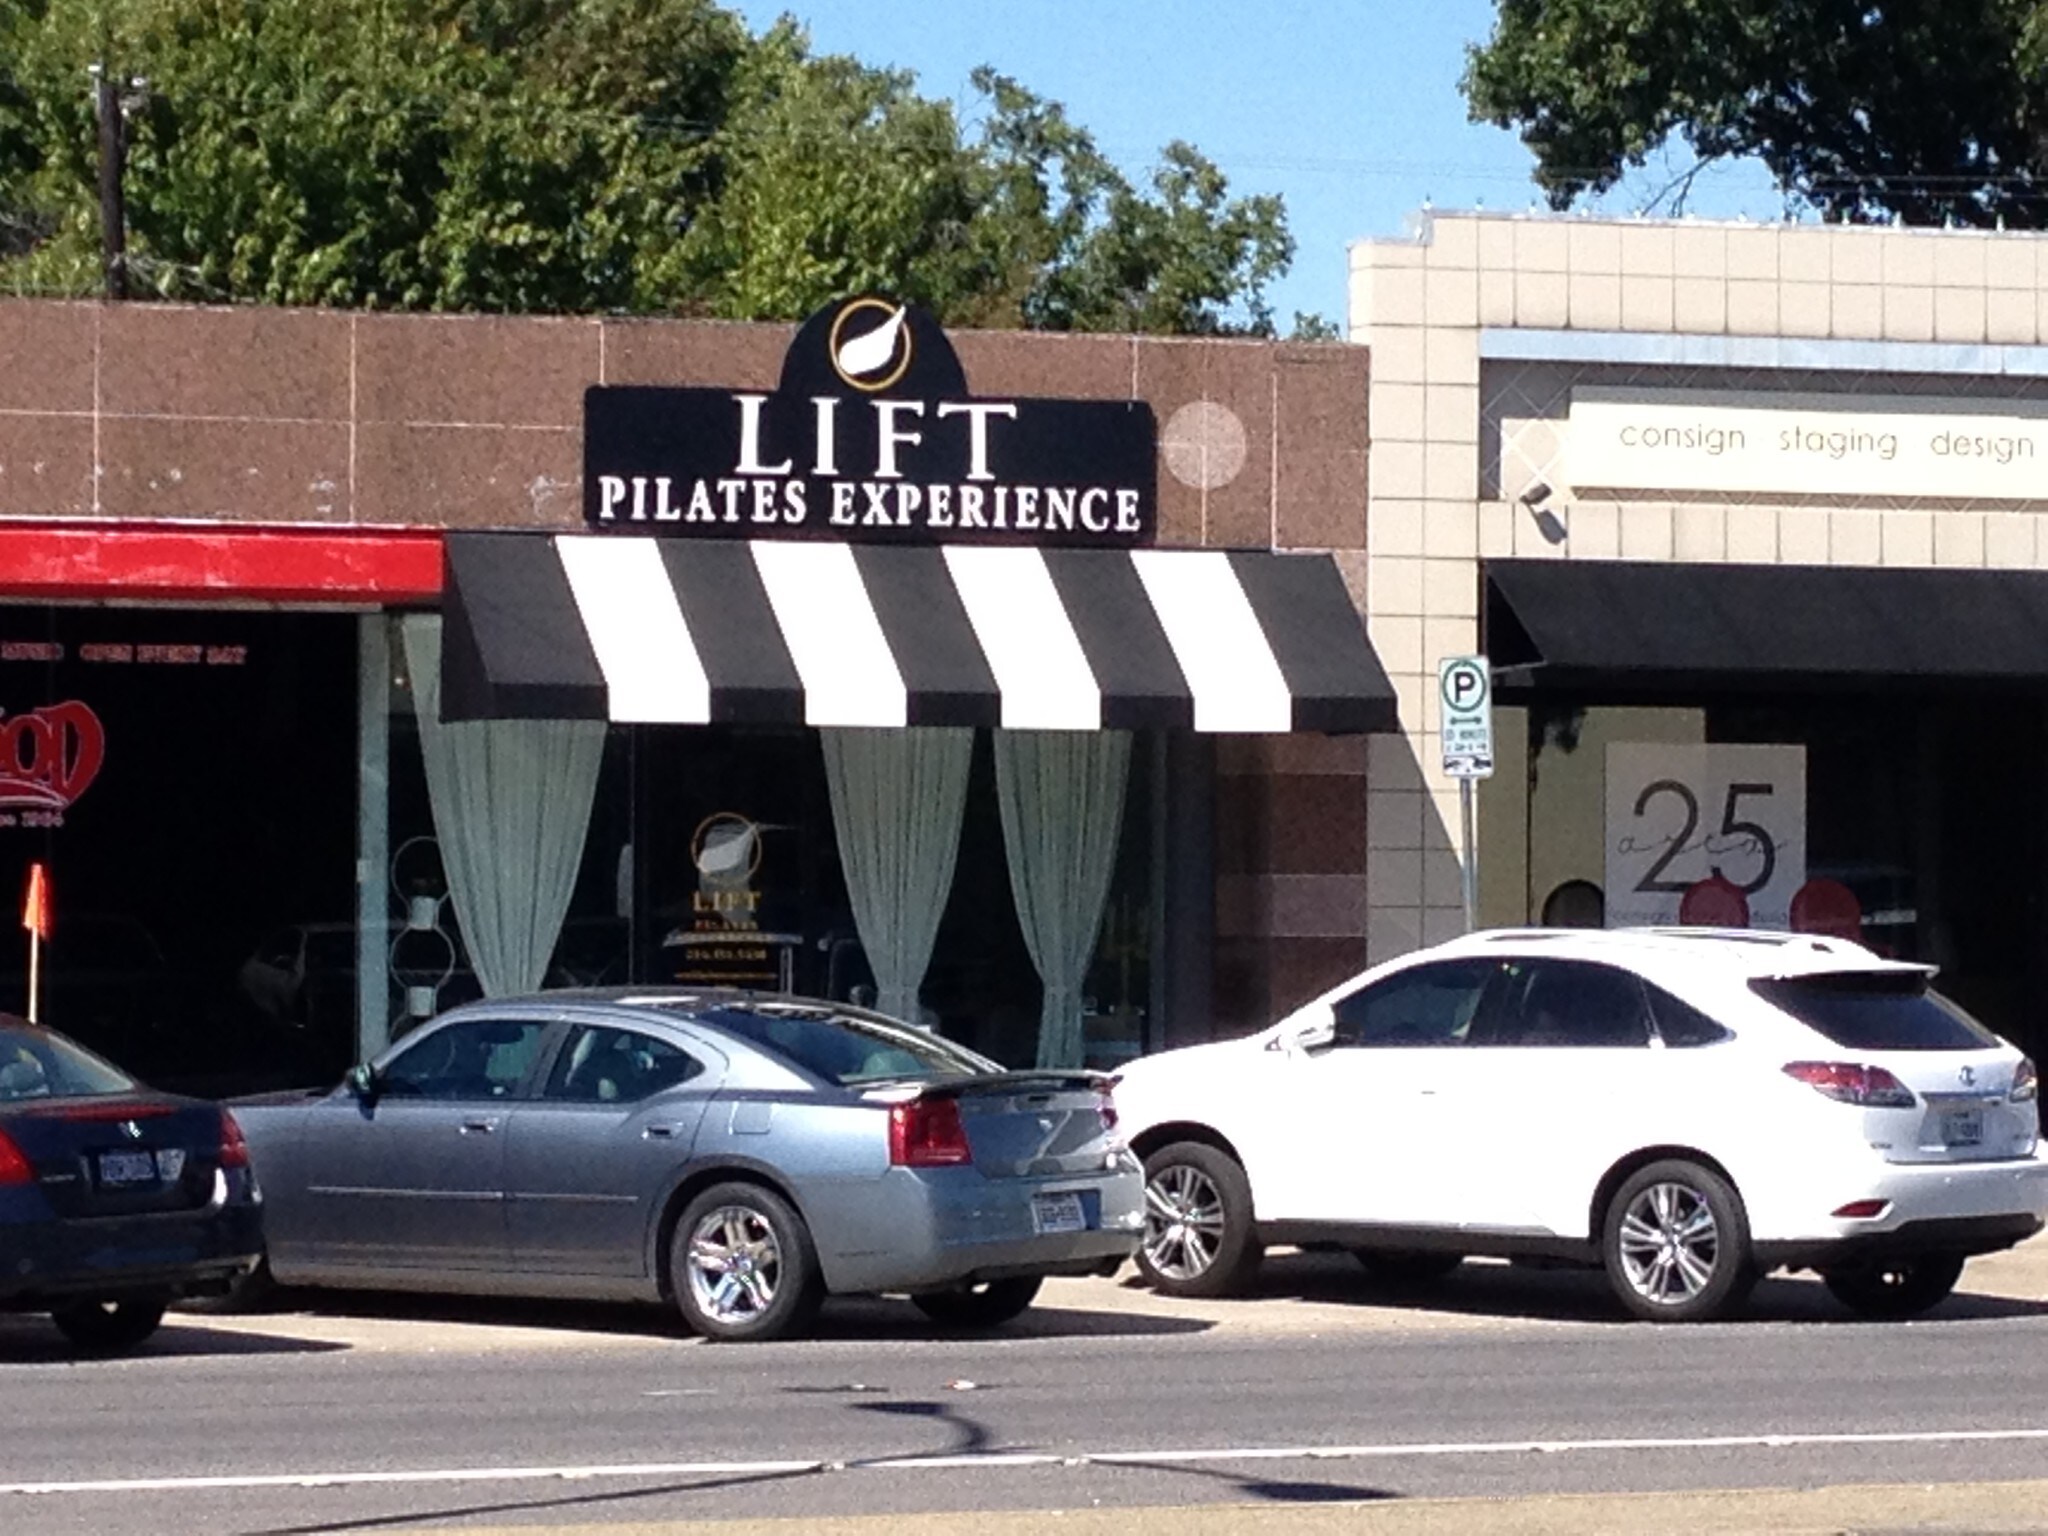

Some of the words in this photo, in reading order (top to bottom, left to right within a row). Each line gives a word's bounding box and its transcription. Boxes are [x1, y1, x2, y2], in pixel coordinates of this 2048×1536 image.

[732, 394, 1017, 481] LIFT
[1619, 424, 1745, 456] consign
[1780, 425, 1898, 460] staging
[1931, 430, 2034, 464] design
[598, 475, 807, 525] PILATES
[830, 481, 1142, 533] EXPERIENCE
[1454, 671, 1476, 703] P
[1634, 779, 1775, 895] 25
[693, 890, 762, 912] LIFT
